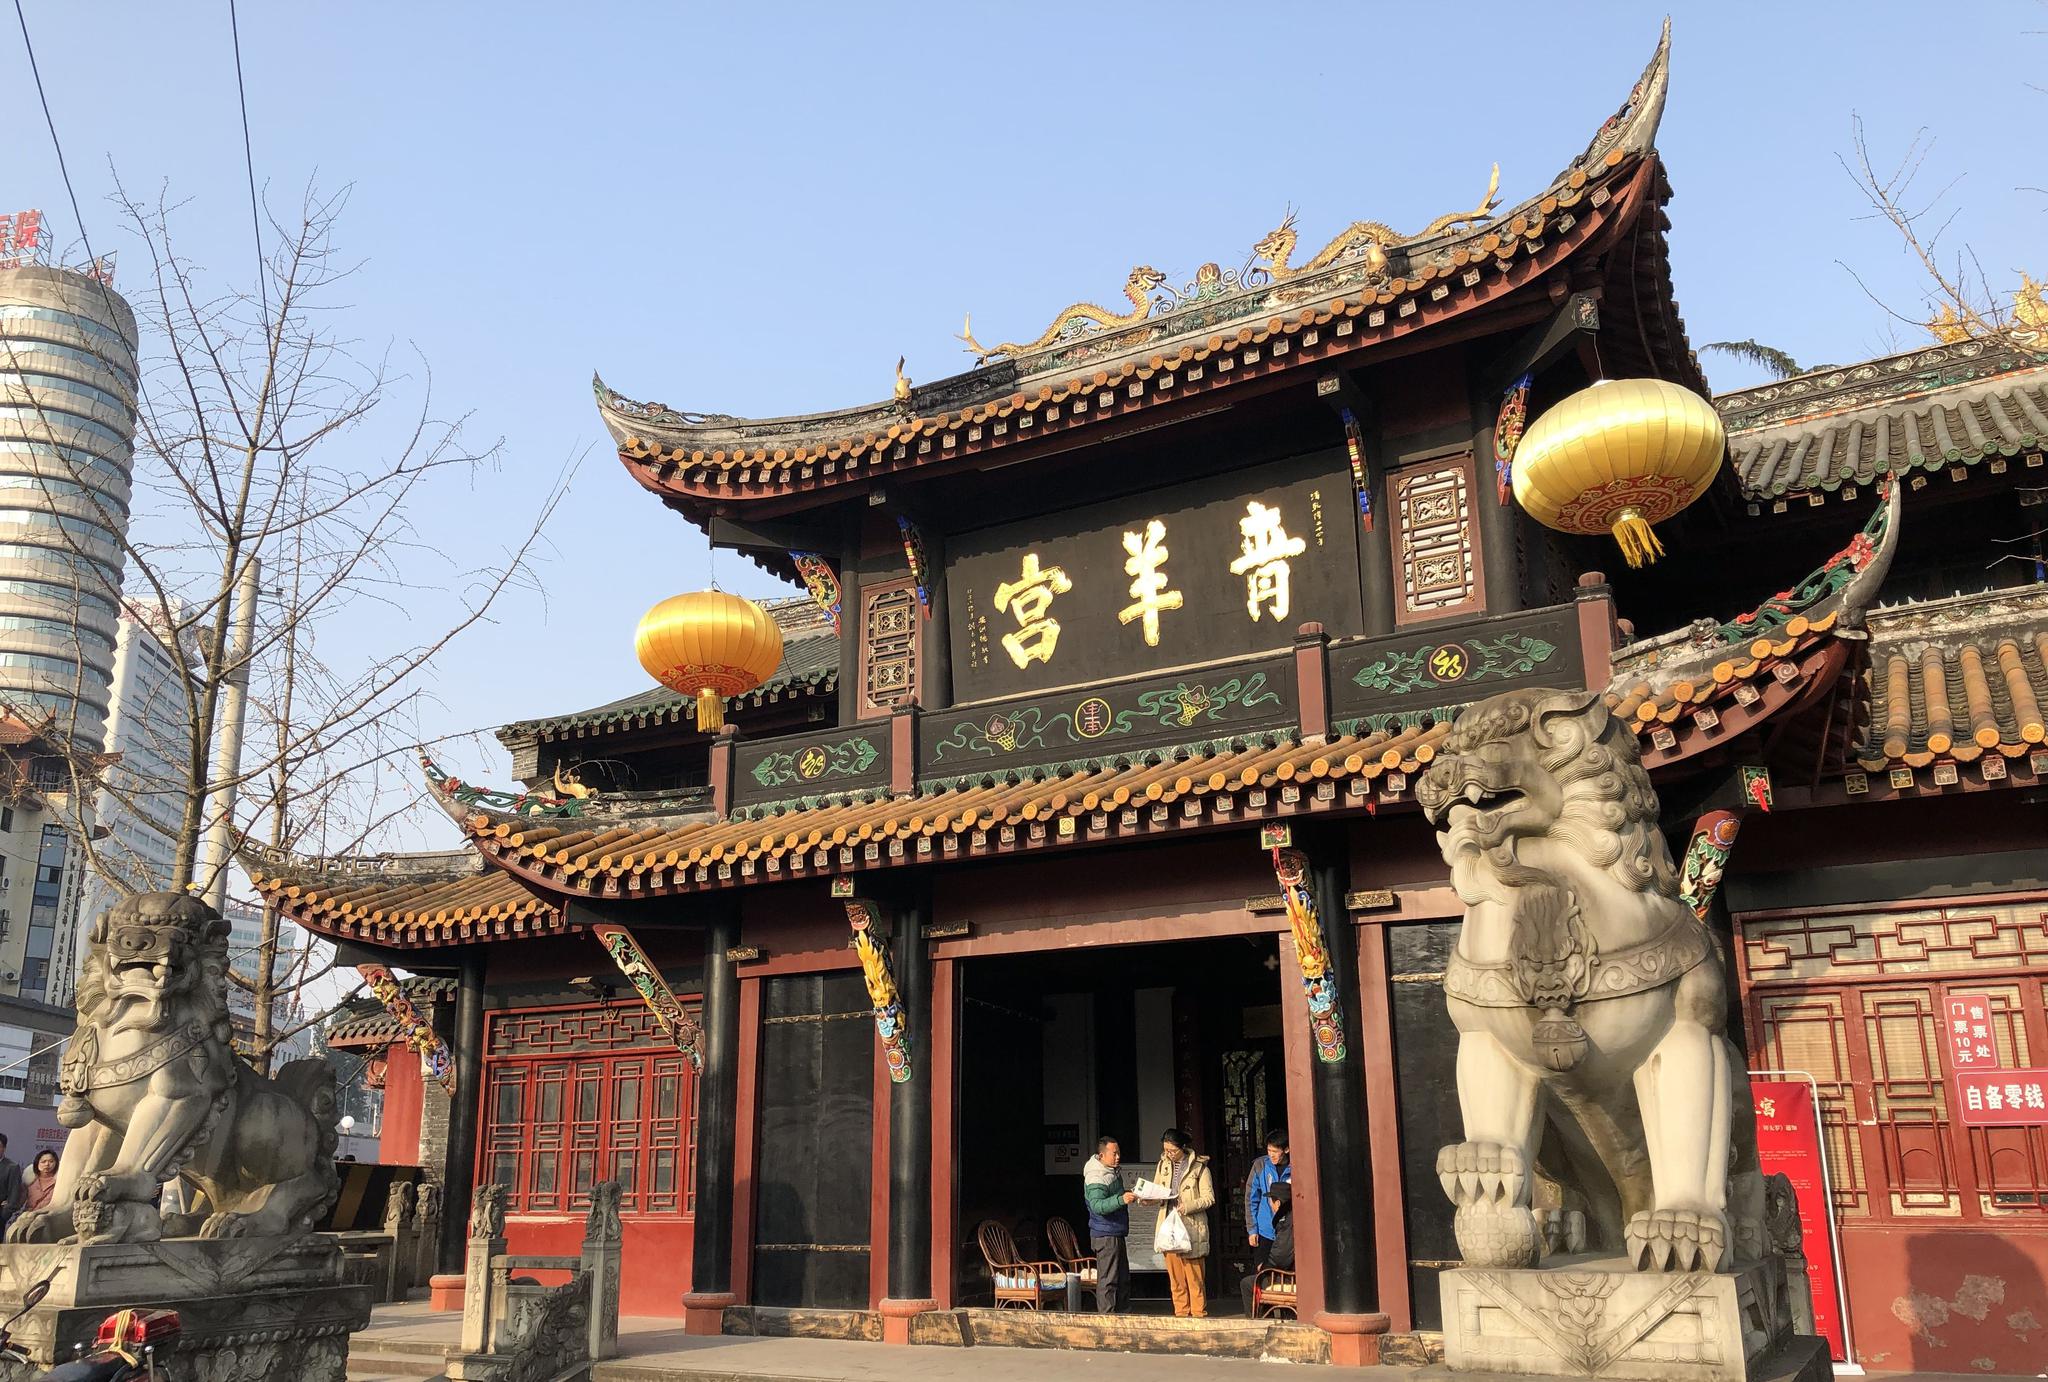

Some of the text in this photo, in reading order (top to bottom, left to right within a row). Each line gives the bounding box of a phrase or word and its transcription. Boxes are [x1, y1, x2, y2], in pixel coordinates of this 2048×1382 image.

[1951, 1002, 1973, 1063] 门票10元
[1970, 1006, 1991, 1058] 售票处
[1966, 1083, 2046, 1110] 自备零钱
